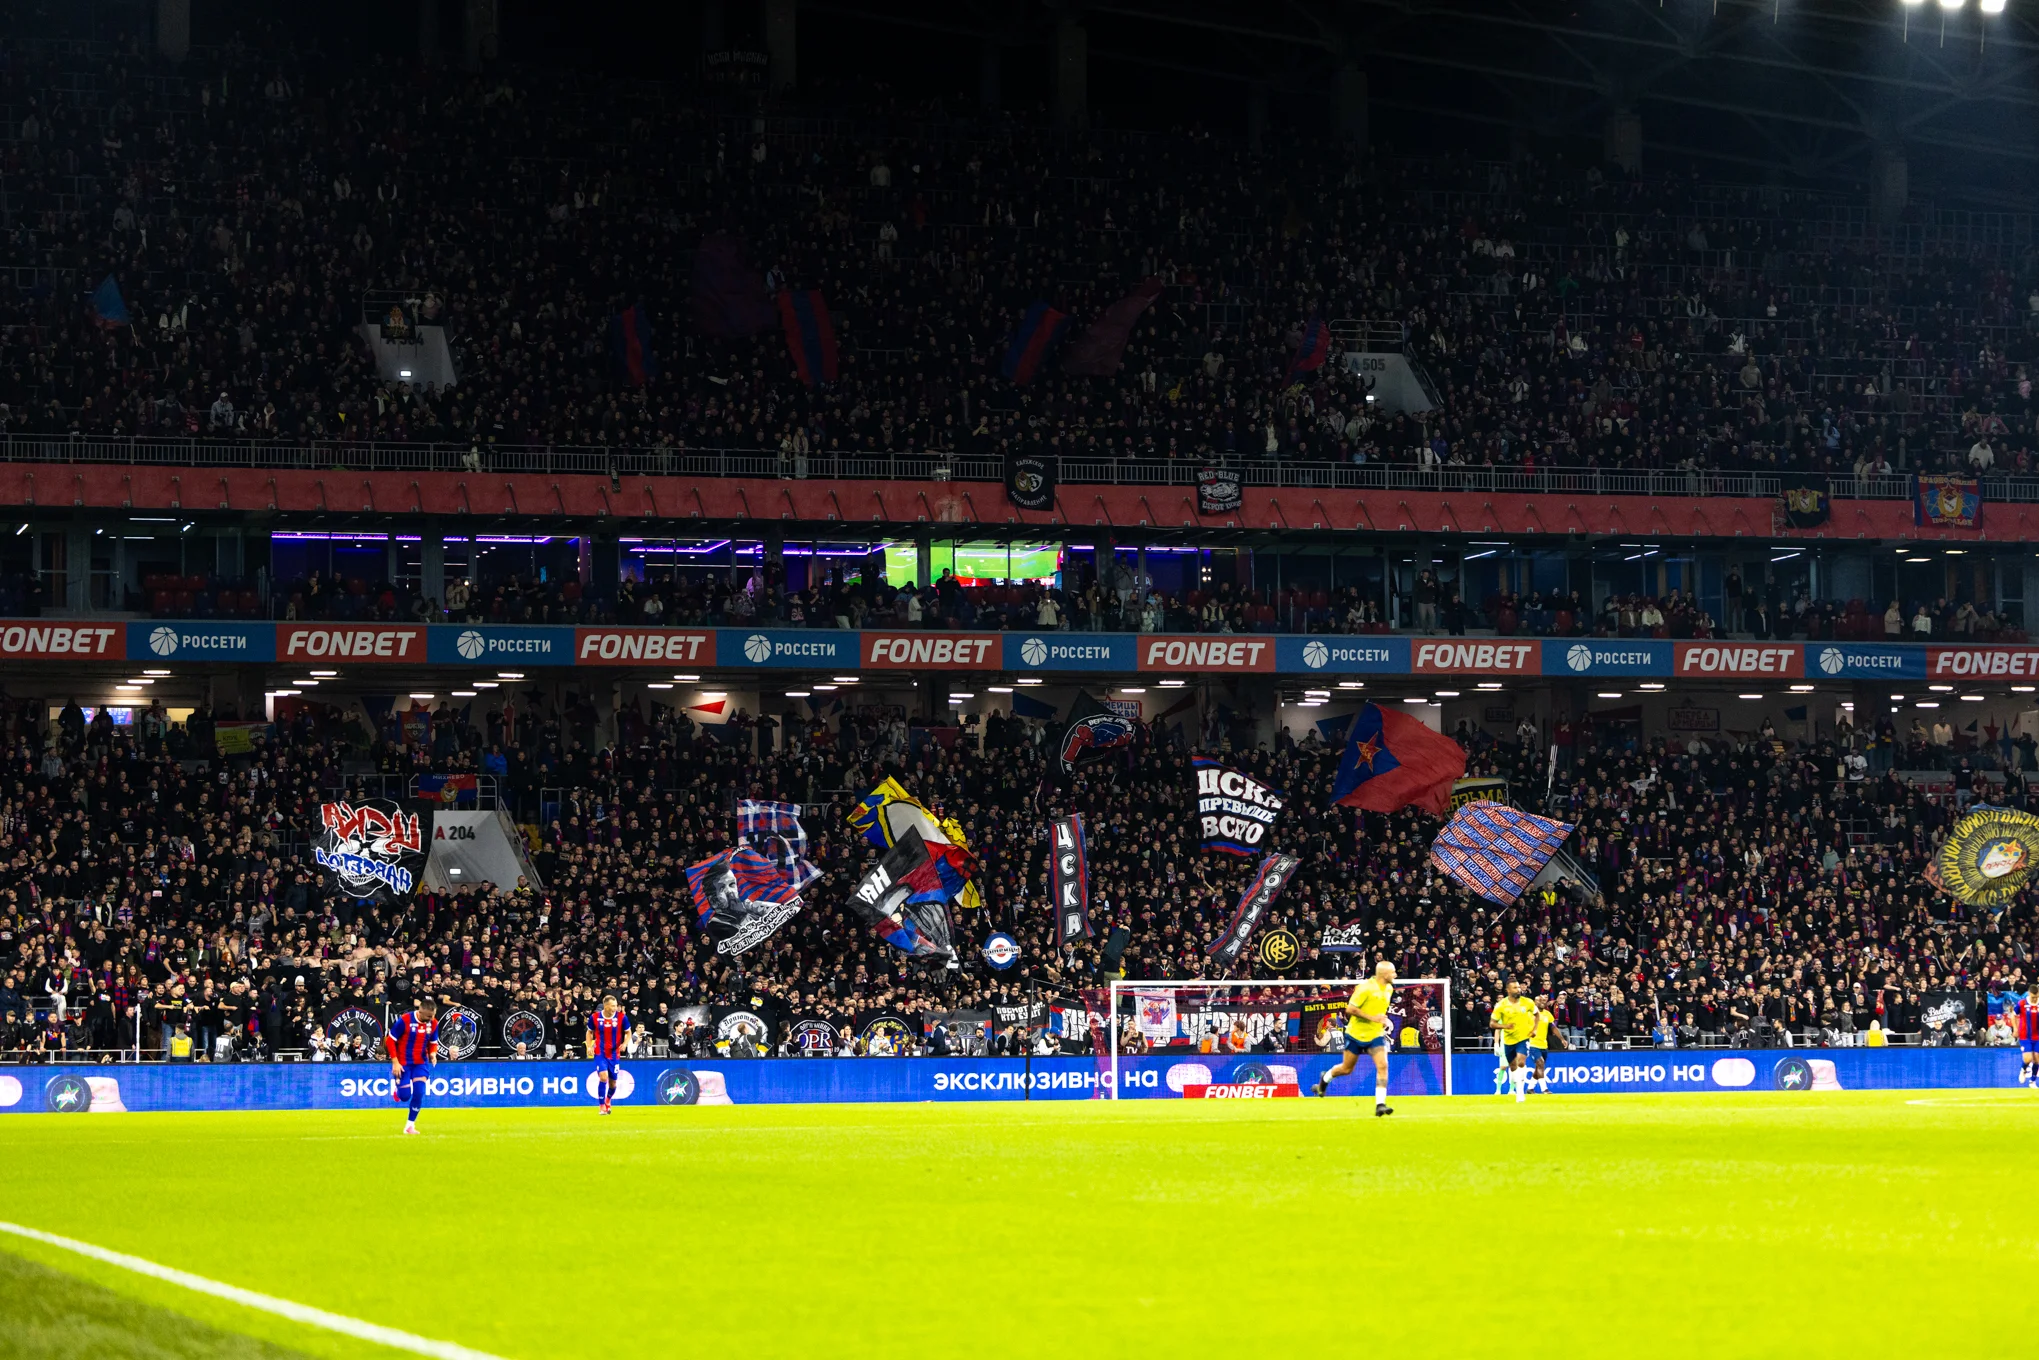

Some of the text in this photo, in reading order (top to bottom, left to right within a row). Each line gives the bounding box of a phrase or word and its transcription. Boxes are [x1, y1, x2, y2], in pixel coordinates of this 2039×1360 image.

[1362, 359, 1386, 371] 505
[182, 635, 247, 649] РОССЕТИ
[287, 630, 417, 657] FONBET
[488, 639, 551, 653] РОССЕТИ
[580, 634, 706, 660] FONBET
[775, 642, 836, 656] РОССЕТИ
[870, 638, 993, 664] FONBET
[1051, 646, 1110, 659] РОССЕТИ
[1147, 641, 1266, 666] FONBET
[1332, 648, 1390, 661] РОССЕТИ
[1416, 644, 1532, 669] FONBET
[1595, 652, 1651, 665] РОССЕТИ
[1683, 647, 1795, 672] FONBET
[1847, 655, 1902, 668] РОССЕТИ
[1936, 651, 2039, 675] FONBET
[1197, 768, 1282, 809] ЦСКА
[1199, 797, 1277, 824] ПРЕВЫШЕ
[434, 826, 475, 840] A 204
[1056, 821, 1083, 937] ЦСКА
[1224, 856, 1295, 957] МОСКВА
[1323, 923, 1362, 939] 100%
[1320, 935, 1363, 947] ЦСКА
[1305, 1003, 1326, 1012] БЫТЬ
[1000, 1013, 1017, 1022] КТО
[1125, 1046, 1138, 1054] TV
[933, 1070, 1159, 1091] эксклюзивно на
[1673, 1064, 1705, 1081] на
[340, 1077, 578, 1097] эксюзивно на
[1204, 1084, 1278, 1099] FONBET
